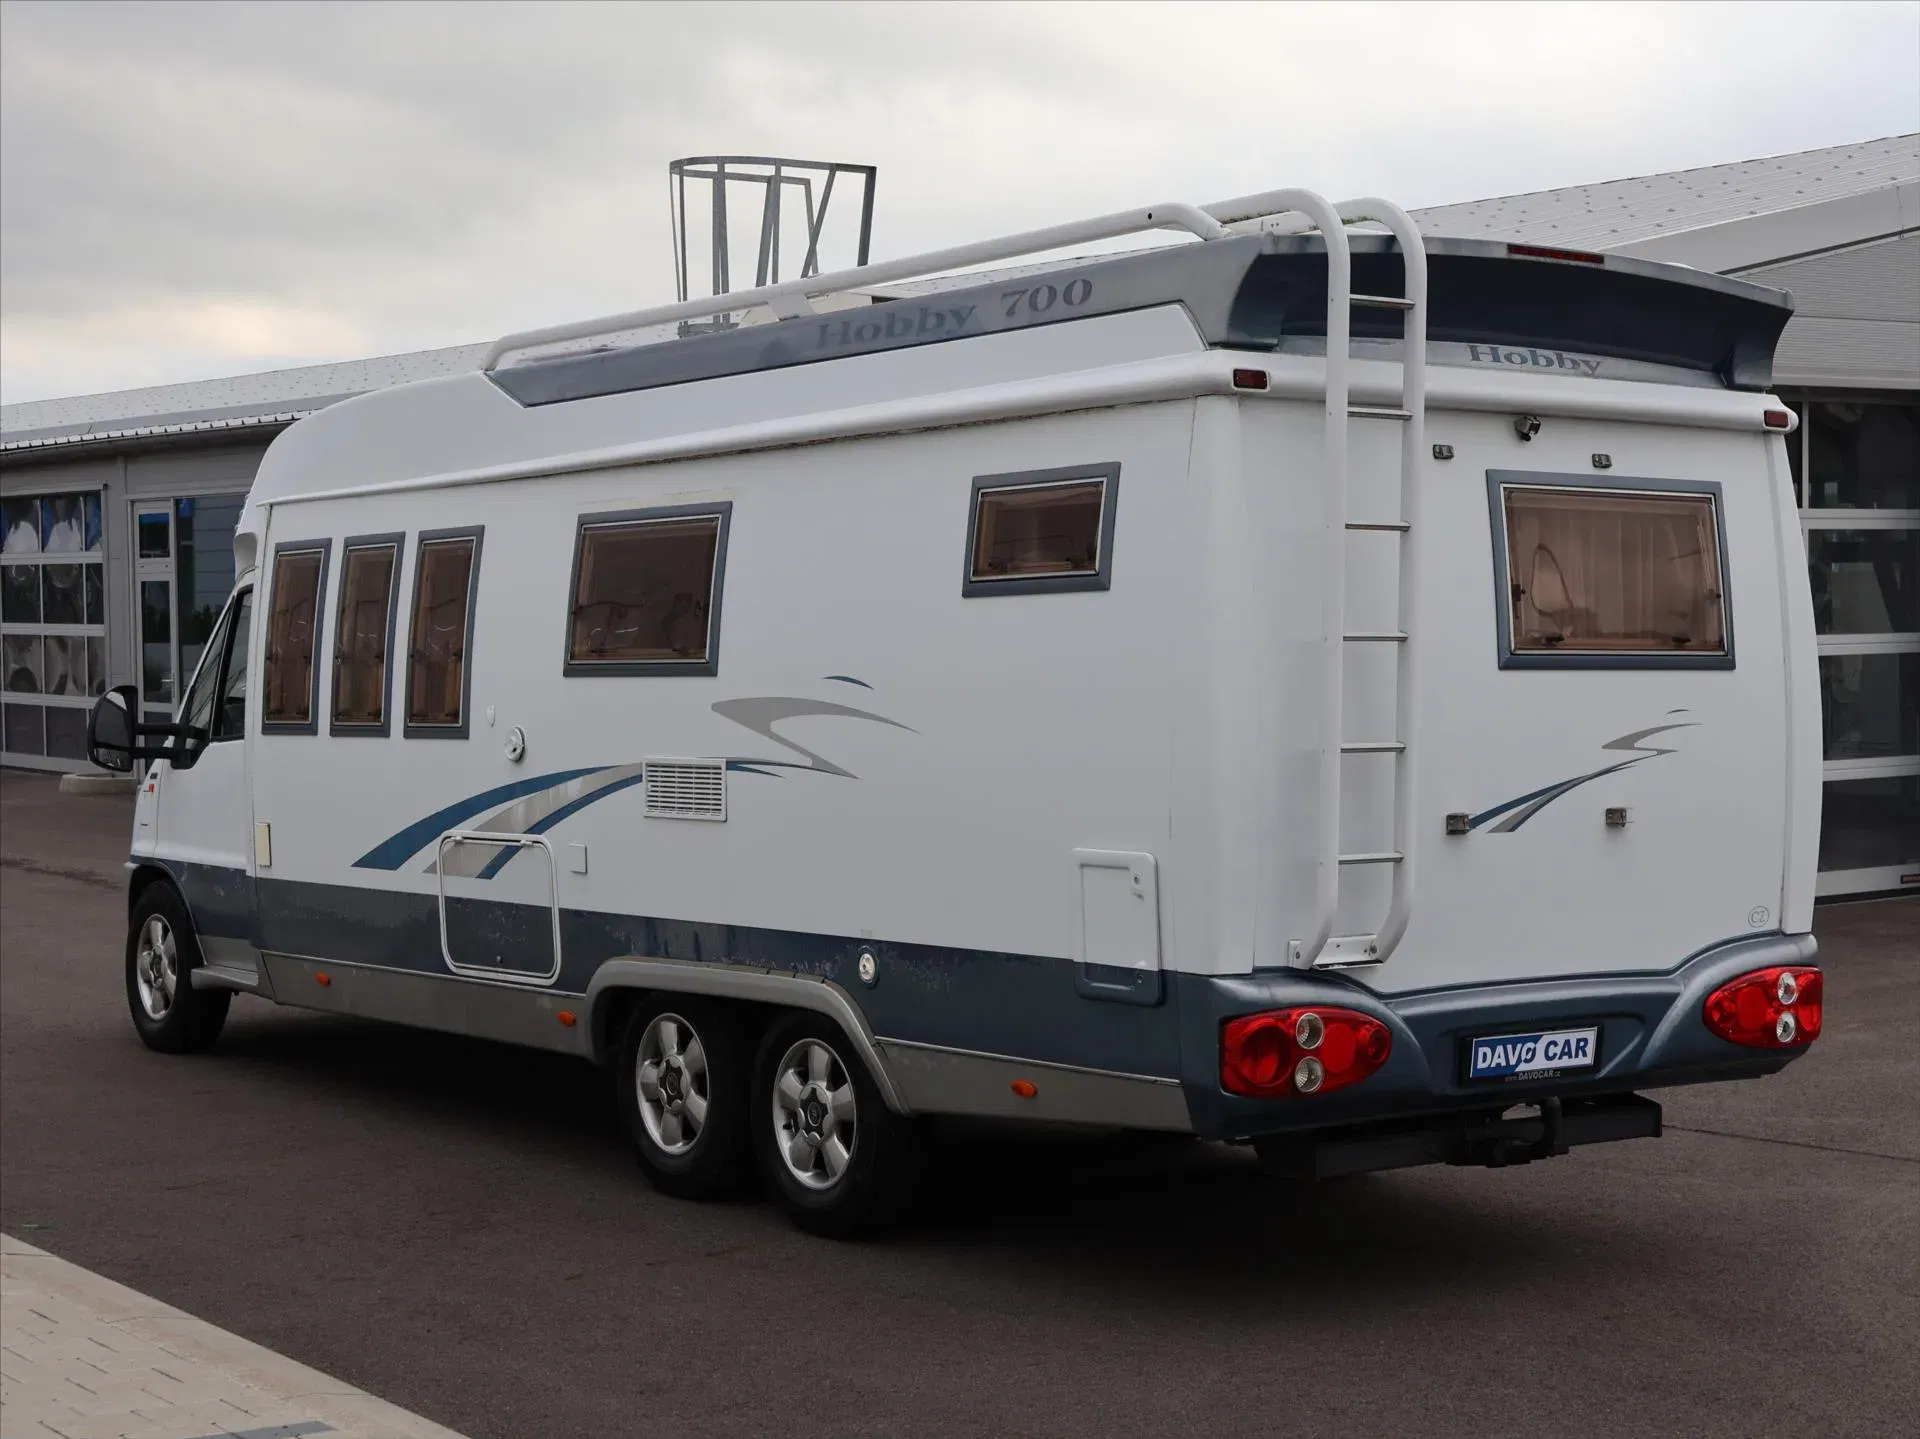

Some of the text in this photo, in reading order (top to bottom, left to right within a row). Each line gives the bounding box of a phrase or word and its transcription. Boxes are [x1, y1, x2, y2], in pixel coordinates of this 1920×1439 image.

[815, 277, 1094, 350] Hobby 700
[1467, 344, 1603, 377] Hobby
[1543, 1036, 1590, 1063] CAR
